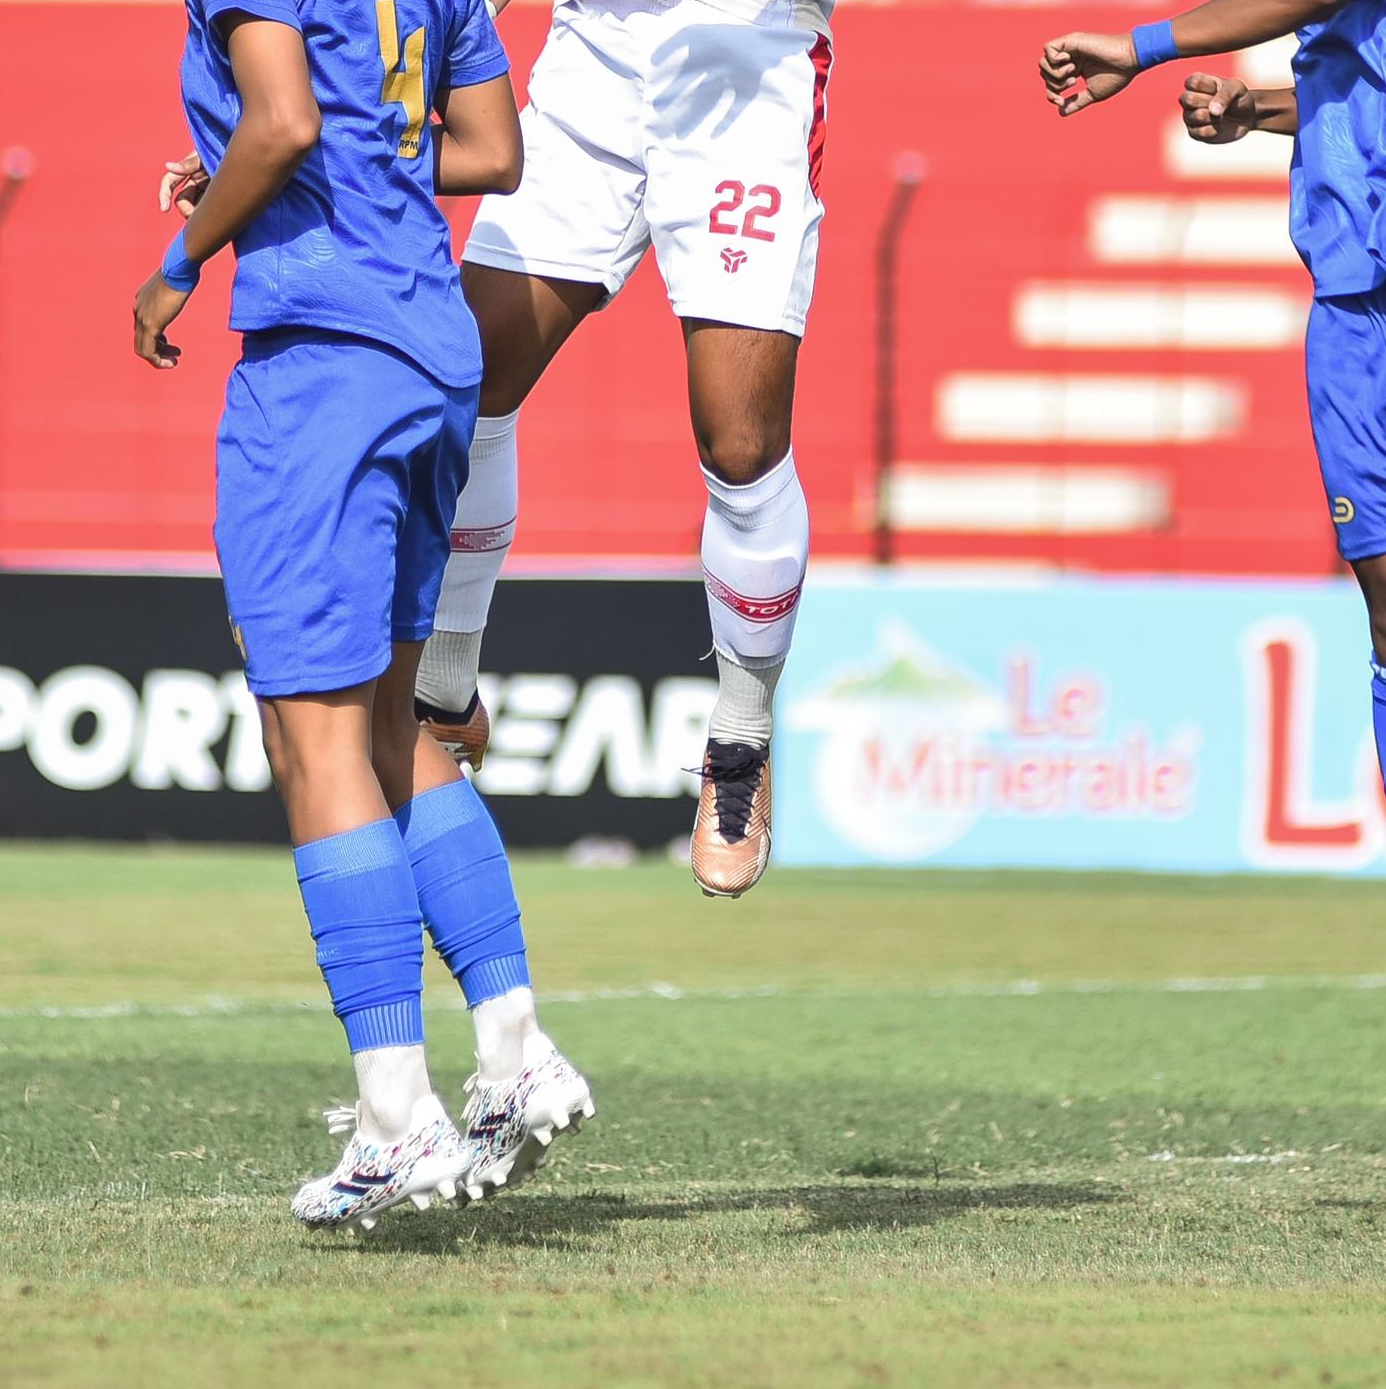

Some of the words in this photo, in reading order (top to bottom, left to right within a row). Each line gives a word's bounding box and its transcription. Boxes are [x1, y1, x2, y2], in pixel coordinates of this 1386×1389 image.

[709, 180, 781, 242] 22
[1006, 657, 1102, 739] Le
[858, 727, 1195, 813] Minerale
